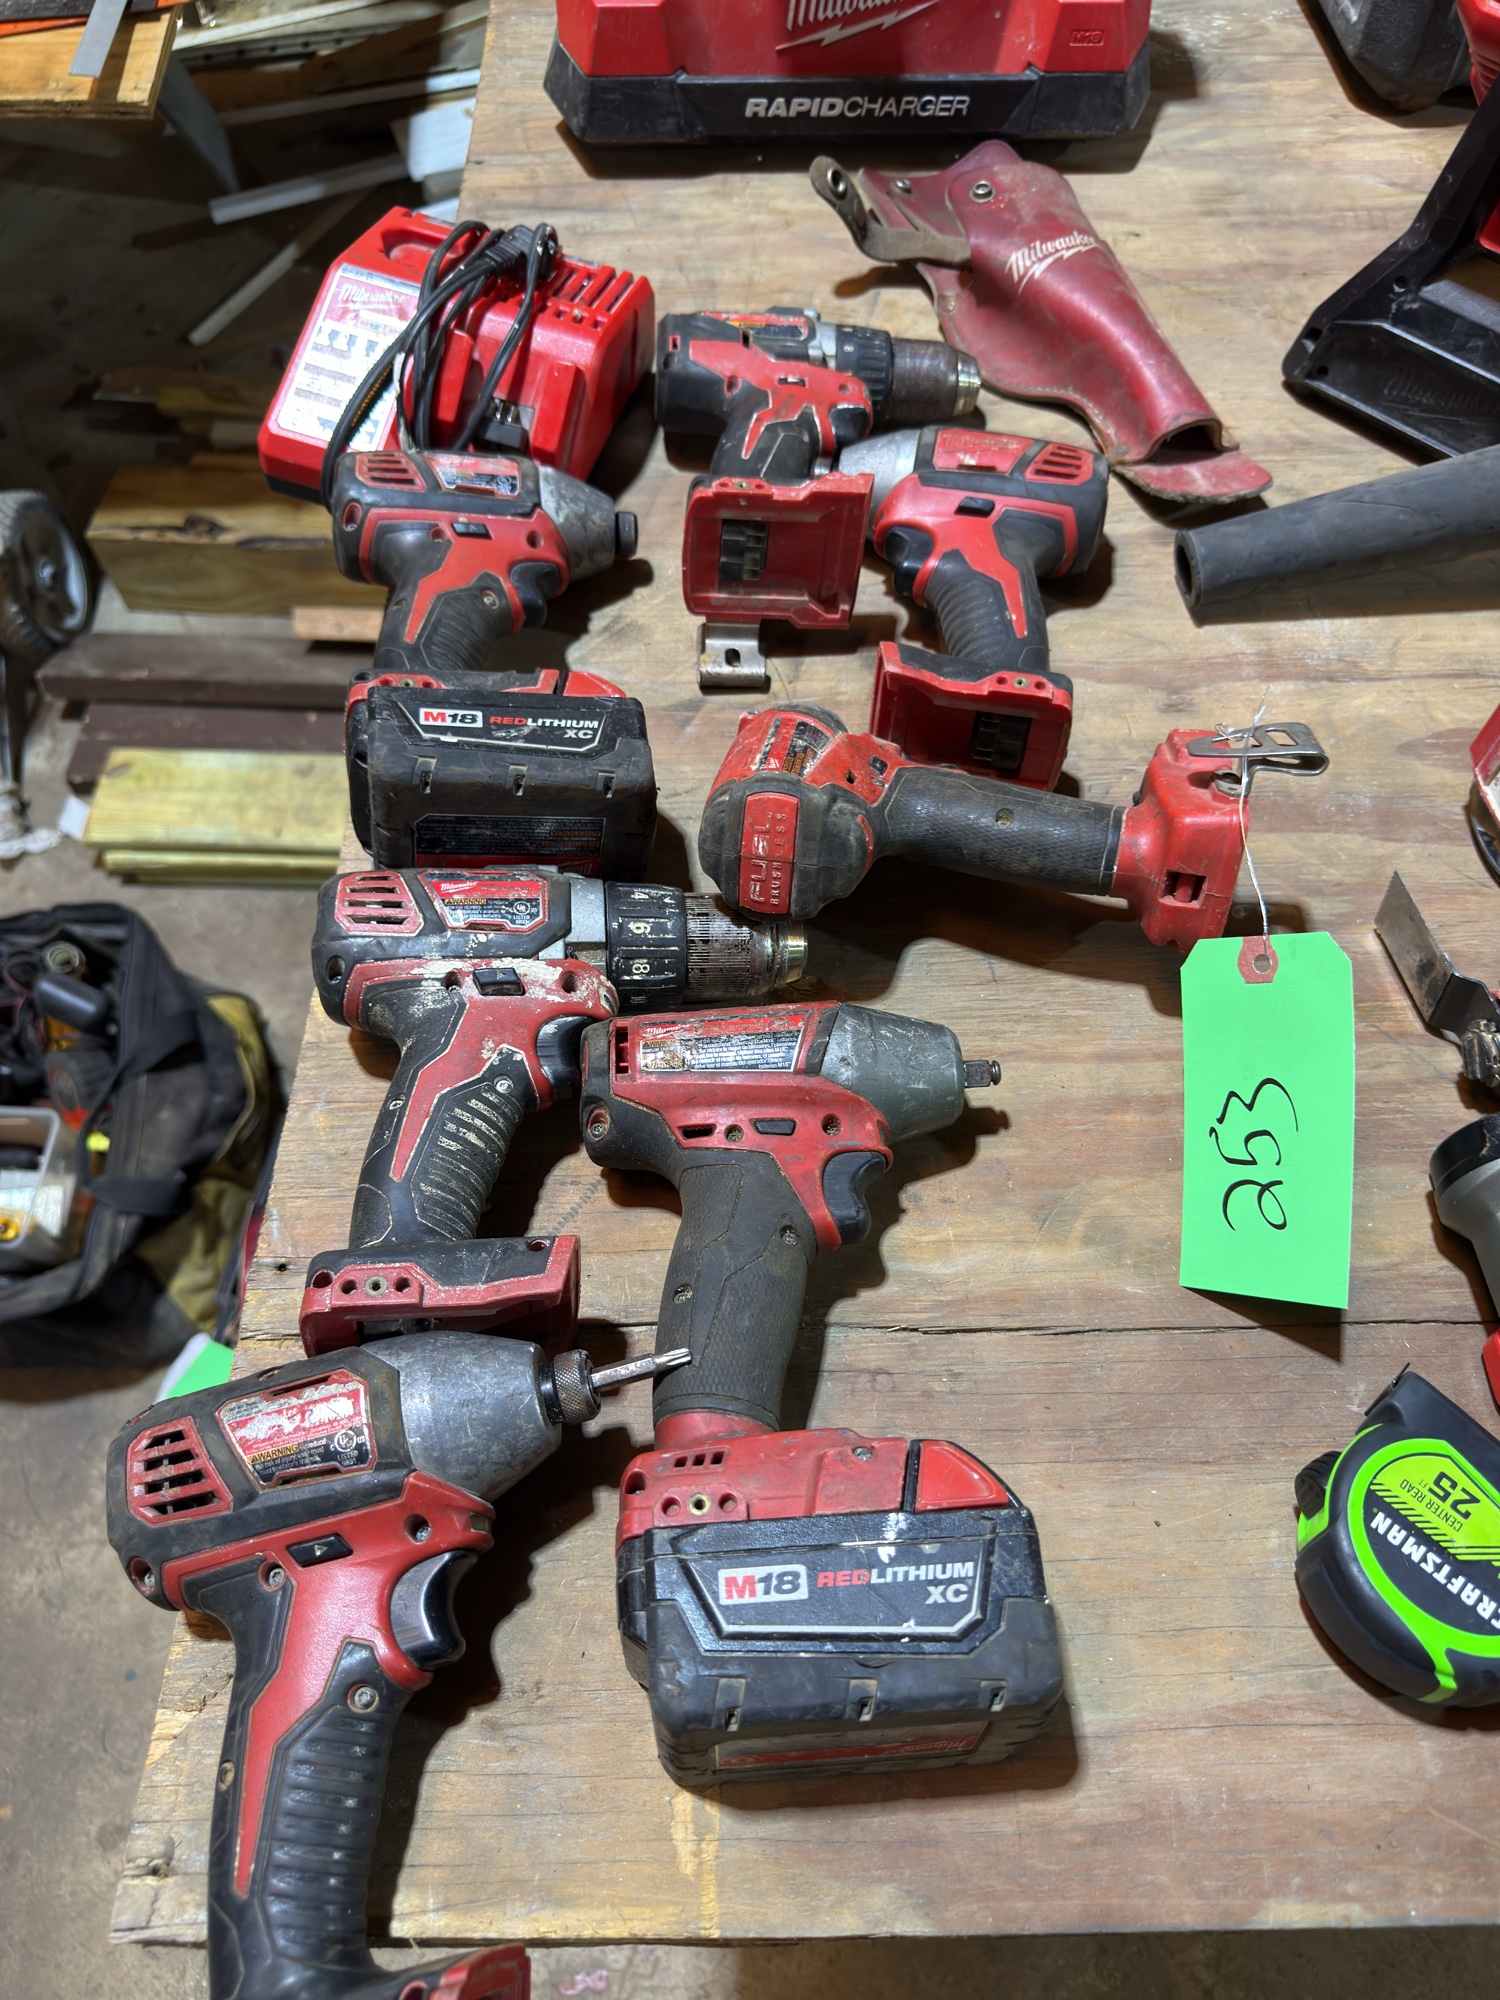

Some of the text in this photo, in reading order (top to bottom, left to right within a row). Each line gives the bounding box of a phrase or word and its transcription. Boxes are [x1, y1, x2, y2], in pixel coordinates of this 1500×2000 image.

[745, 96, 970, 117] RAPIDCHARGER
[424, 711, 599, 729] M18 REDLITHIUM
[562, 729, 594, 739] XC
[749, 826, 770, 903] FUEL
[770, 813, 786, 905] BRUSHLESS
[441, 881, 478, 891] Milwaukee
[632, 963, 650, 974] 8
[1209, 1077, 1299, 1232] 253
[257, 1443, 298, 1462] WARNING
[337, 1450, 359, 1461] LISTED
[1400, 1479, 1463, 1532] CENTER READ
[1418, 1471, 1481, 1520] 25 FT
[724, 1562, 974, 1599] M18 REDLITHIUM
[925, 1583, 969, 1604] XC
